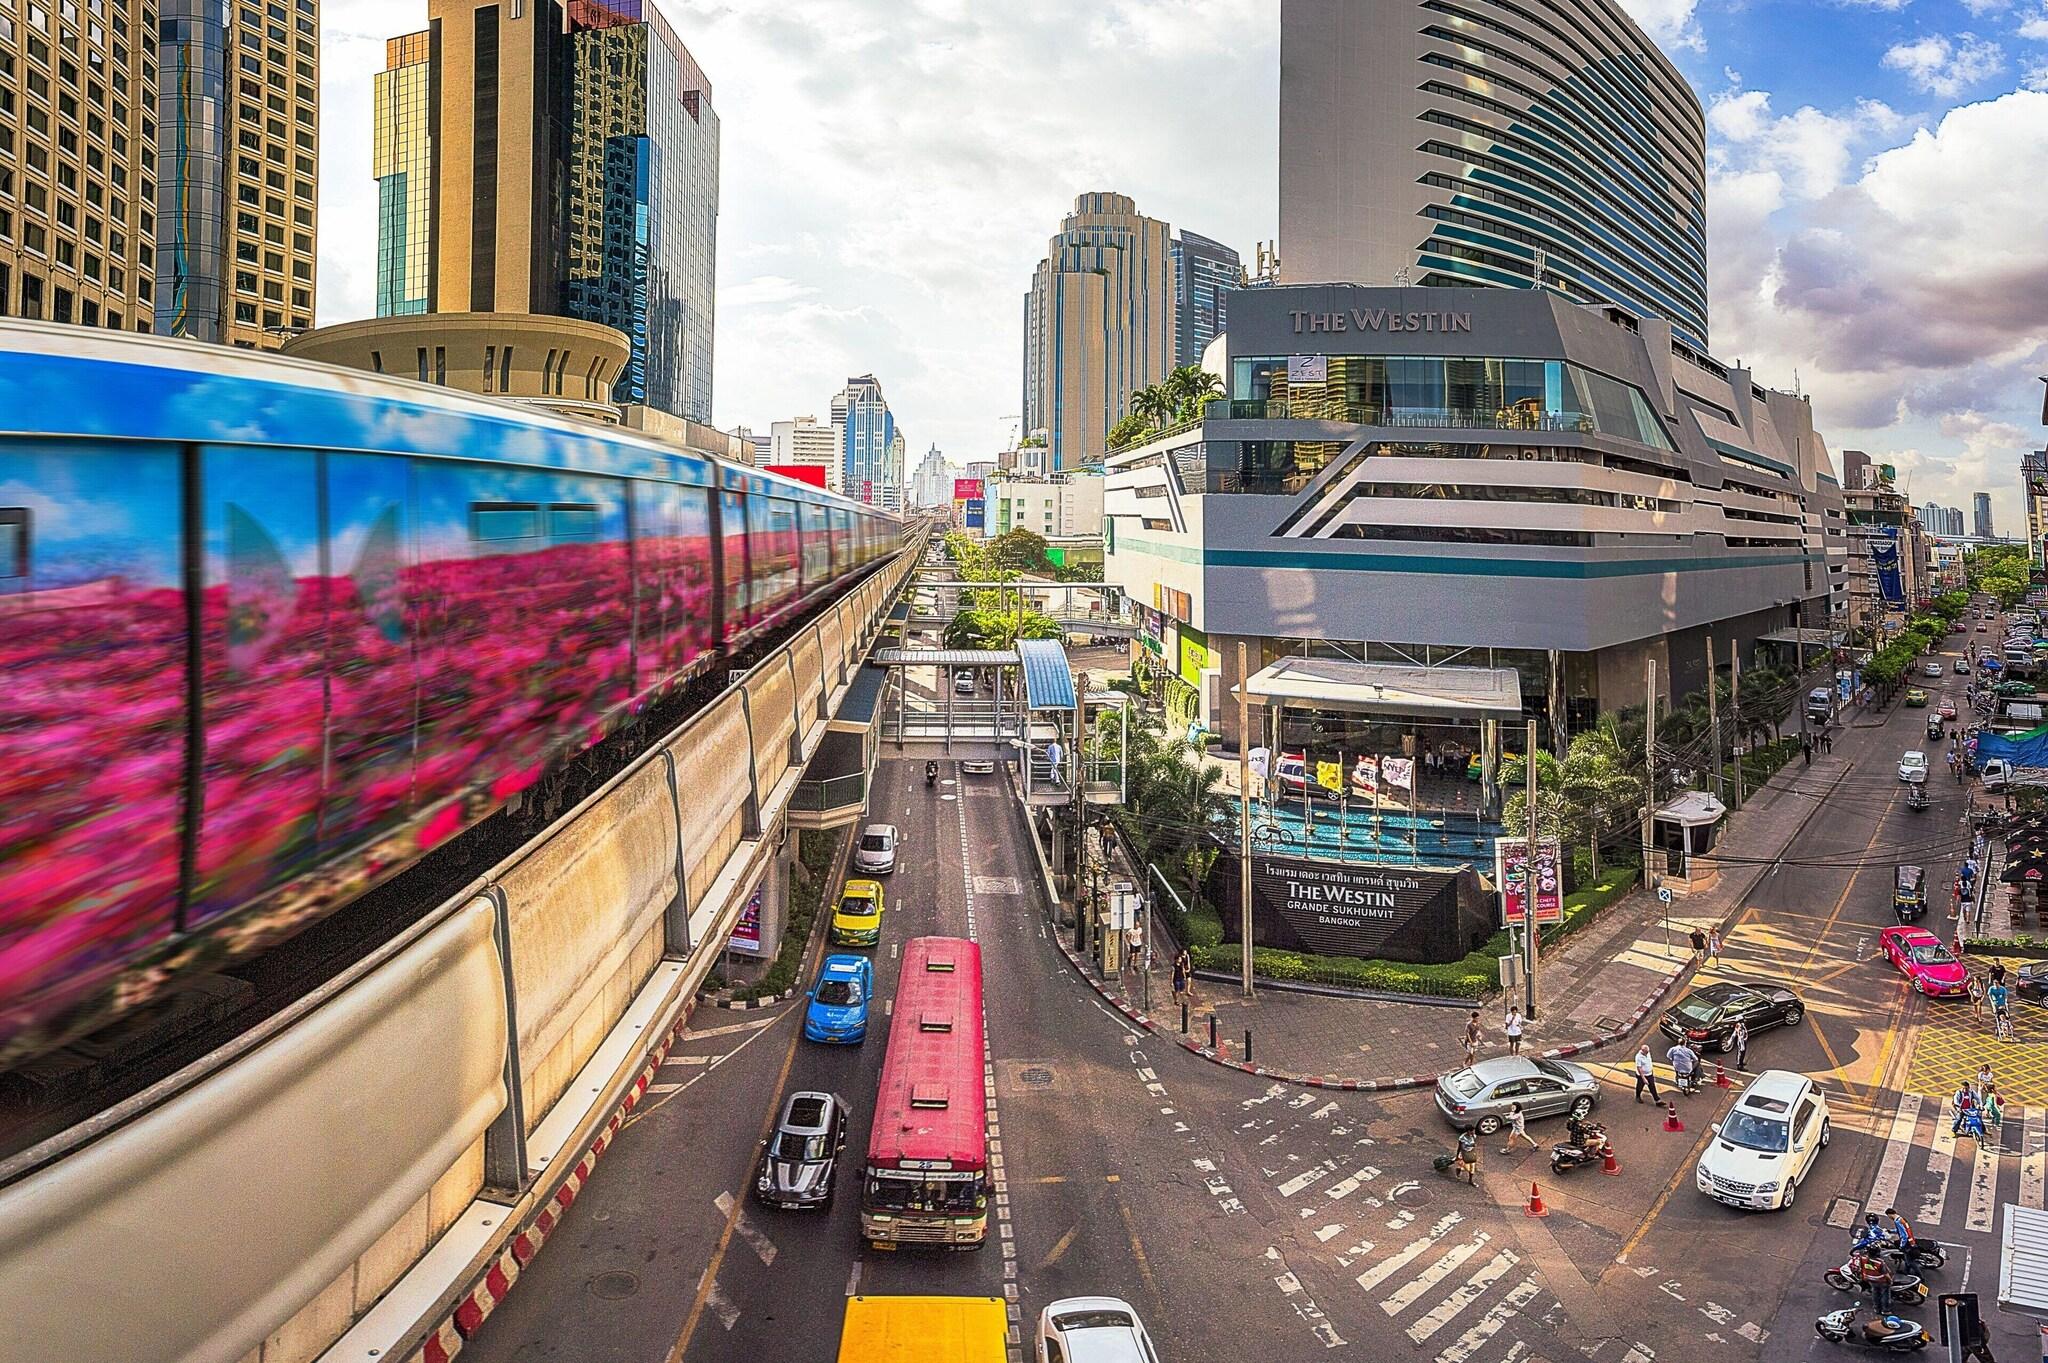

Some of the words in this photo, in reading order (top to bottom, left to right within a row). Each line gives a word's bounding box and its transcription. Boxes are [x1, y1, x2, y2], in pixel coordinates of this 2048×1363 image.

[1264, 863, 1297, 878] โรงแรม
[1299, 869, 1320, 880] เดอะ
[1352, 872, 1384, 886] แกรนด์
[1386, 877, 1419, 891] สุขุมวิท
[1287, 900, 1329, 913] GRANDE
[1332, 904, 1395, 919] SUKHUMVIT
[1319, 916, 1361, 927] BANGKOK
